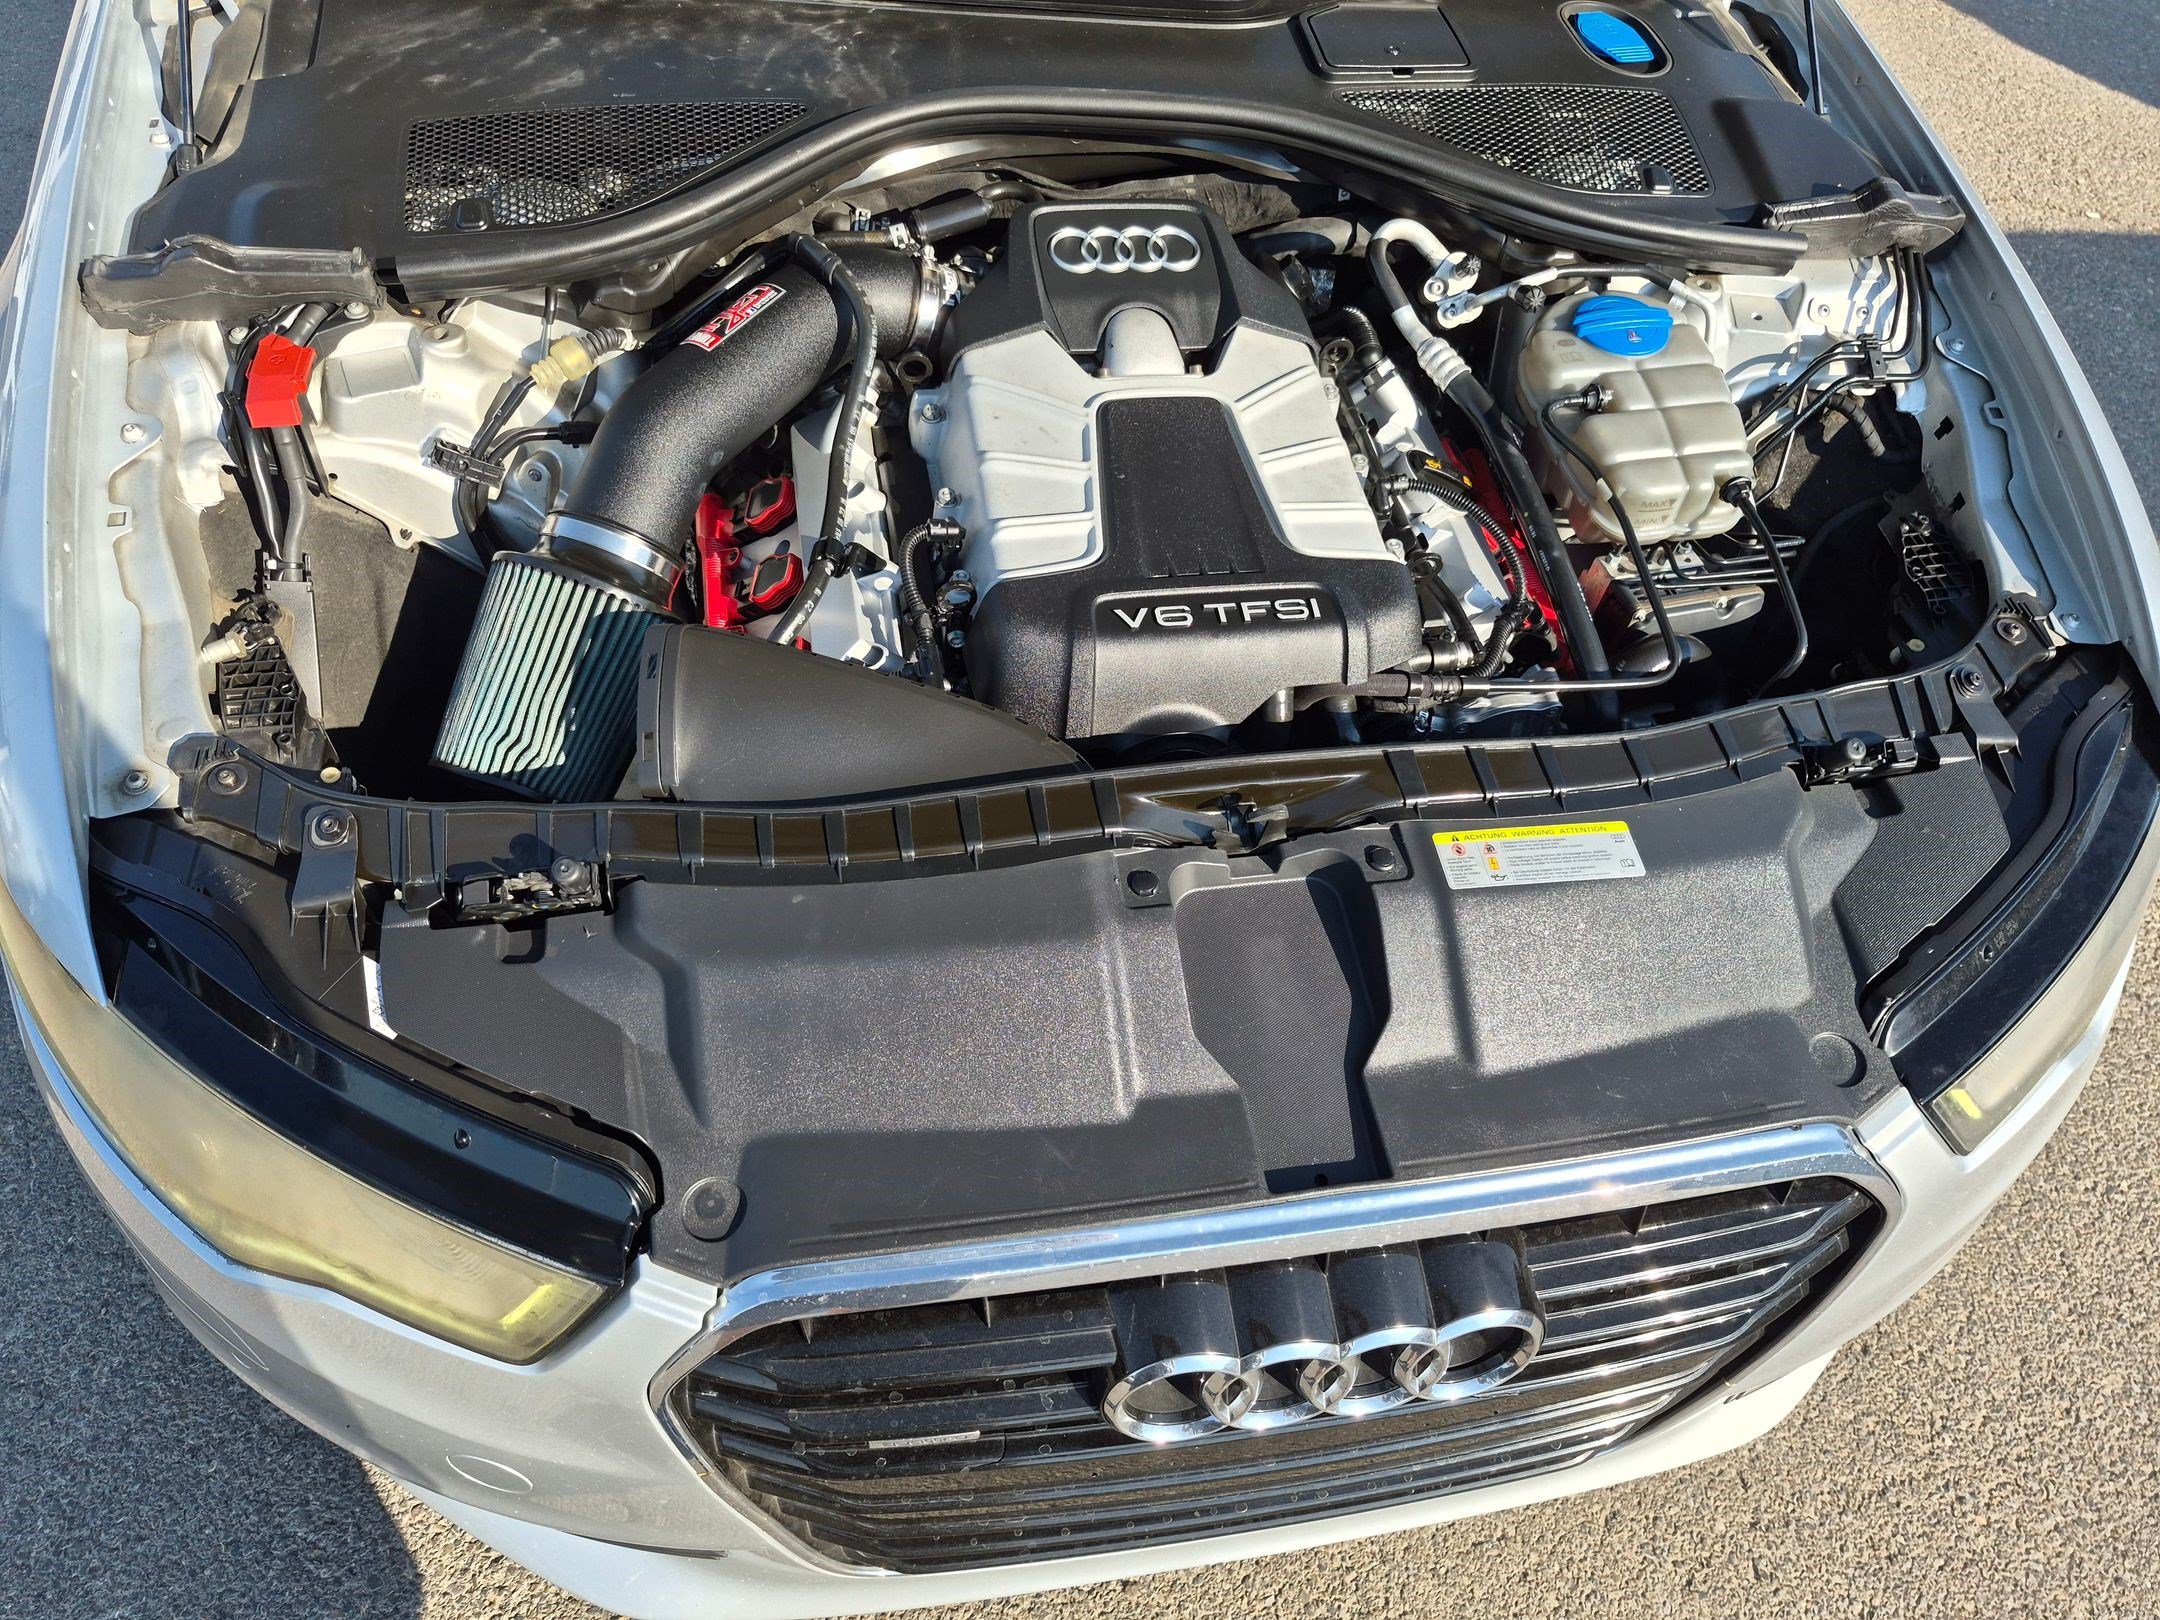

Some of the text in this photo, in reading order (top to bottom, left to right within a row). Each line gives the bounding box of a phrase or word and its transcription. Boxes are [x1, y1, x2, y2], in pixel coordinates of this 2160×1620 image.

[1113, 597, 1322, 631] V6 TFSI
[1463, 824, 1607, 841] ACHTUNG WARNING ATTENTION
